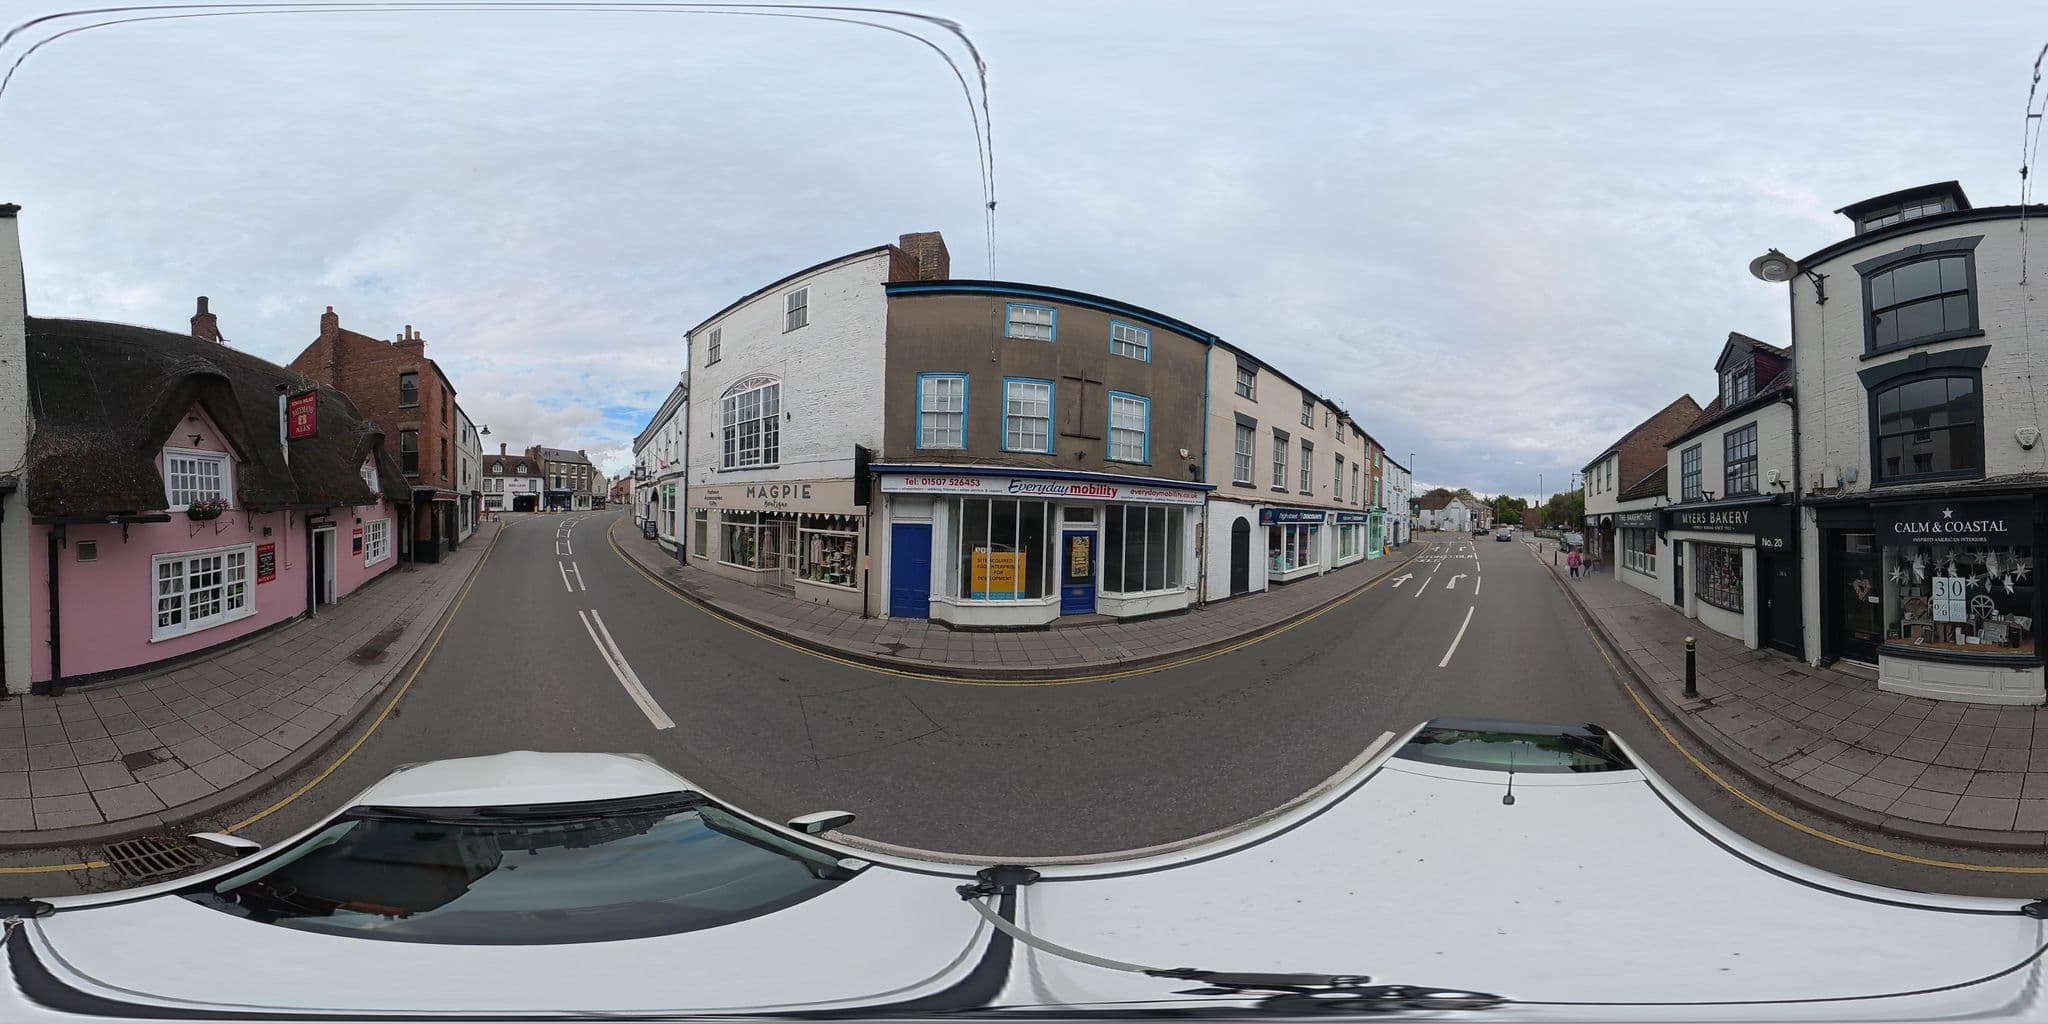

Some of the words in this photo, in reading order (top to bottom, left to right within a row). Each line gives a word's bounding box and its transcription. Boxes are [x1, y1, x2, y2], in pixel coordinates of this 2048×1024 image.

[905, 478, 919, 486] Tel:
[921, 478, 947, 486] 01507
[949, 478, 980, 487] 526453
[1008, 479, 1069, 496] Everyday
[1070, 484, 1118, 498] mobility
[746, 484, 811, 499] MAGPIE
[1130, 488, 1198, 500] everydaymobility.co.uk
[1682, 512, 1706, 523] MYERS
[1710, 510, 1749, 524] BAKERY
[1894, 522, 1930, 533] CALM
[1932, 521, 1943, 533] &
[1944, 520, 2008, 532] COASTAL
[1762, 537, 1773, 547] No.
[1774, 538, 1783, 548] 20
